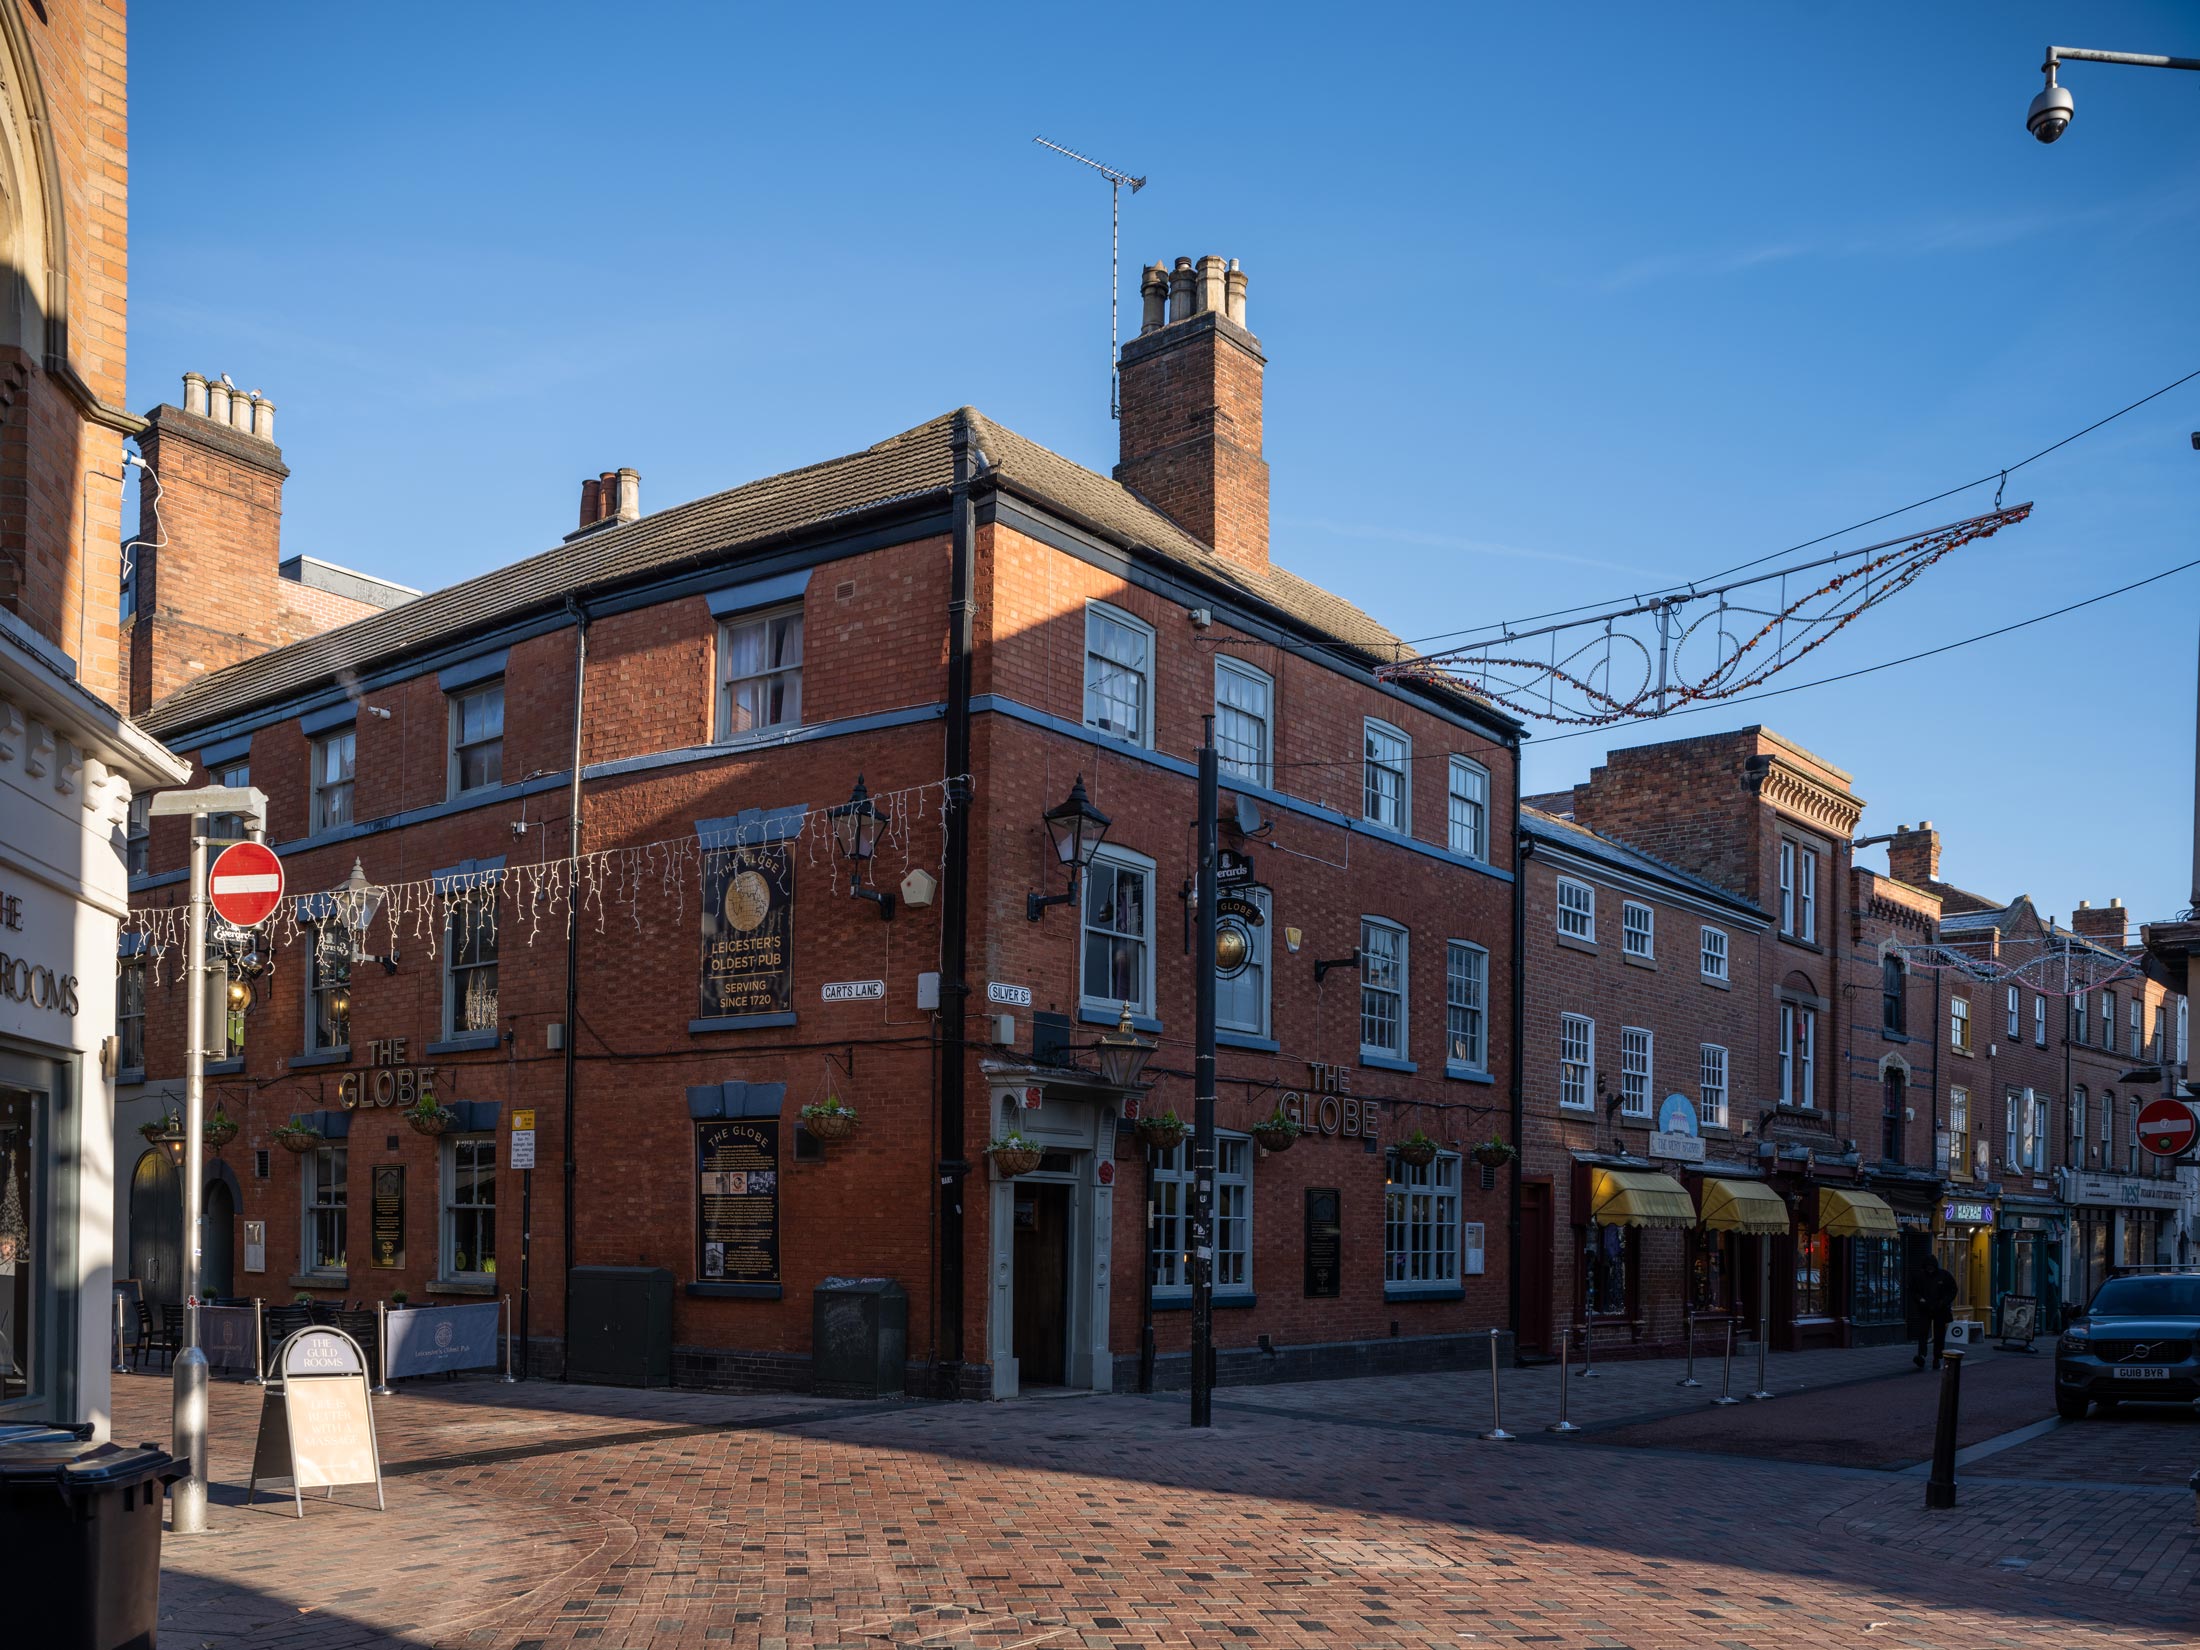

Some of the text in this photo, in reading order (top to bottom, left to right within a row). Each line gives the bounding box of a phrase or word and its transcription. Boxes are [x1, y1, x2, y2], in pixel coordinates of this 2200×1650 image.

[743, 854, 780, 873] GLOBE
[1217, 863, 1248, 878] erards
[0, 890, 23, 932] HE
[1220, 902, 1253, 918] GLOBE
[711, 936, 782, 954] LEICESTER'S
[711, 952, 783, 971] OLDEST PUB
[0, 952, 79, 1017] ROOMS
[725, 980, 766, 994] SERVING
[825, 984, 880, 998] CARTS LANE
[720, 993, 772, 1008] SINCE 1720
[993, 986, 1019, 1001] SILVER
[367, 1037, 406, 1066] THE
[1311, 1061, 1351, 1093] THE
[338, 1067, 434, 1110] GLOBE
[1280, 1091, 1378, 1139] GLOBE
[708, 1125, 769, 1149] THE GLOBE
[313, 1338, 332, 1348] THE
[307, 1348, 338, 1358] GUILD
[303, 1358, 344, 1368] ROOMS
[2144, 1368, 2163, 1377] BYR
